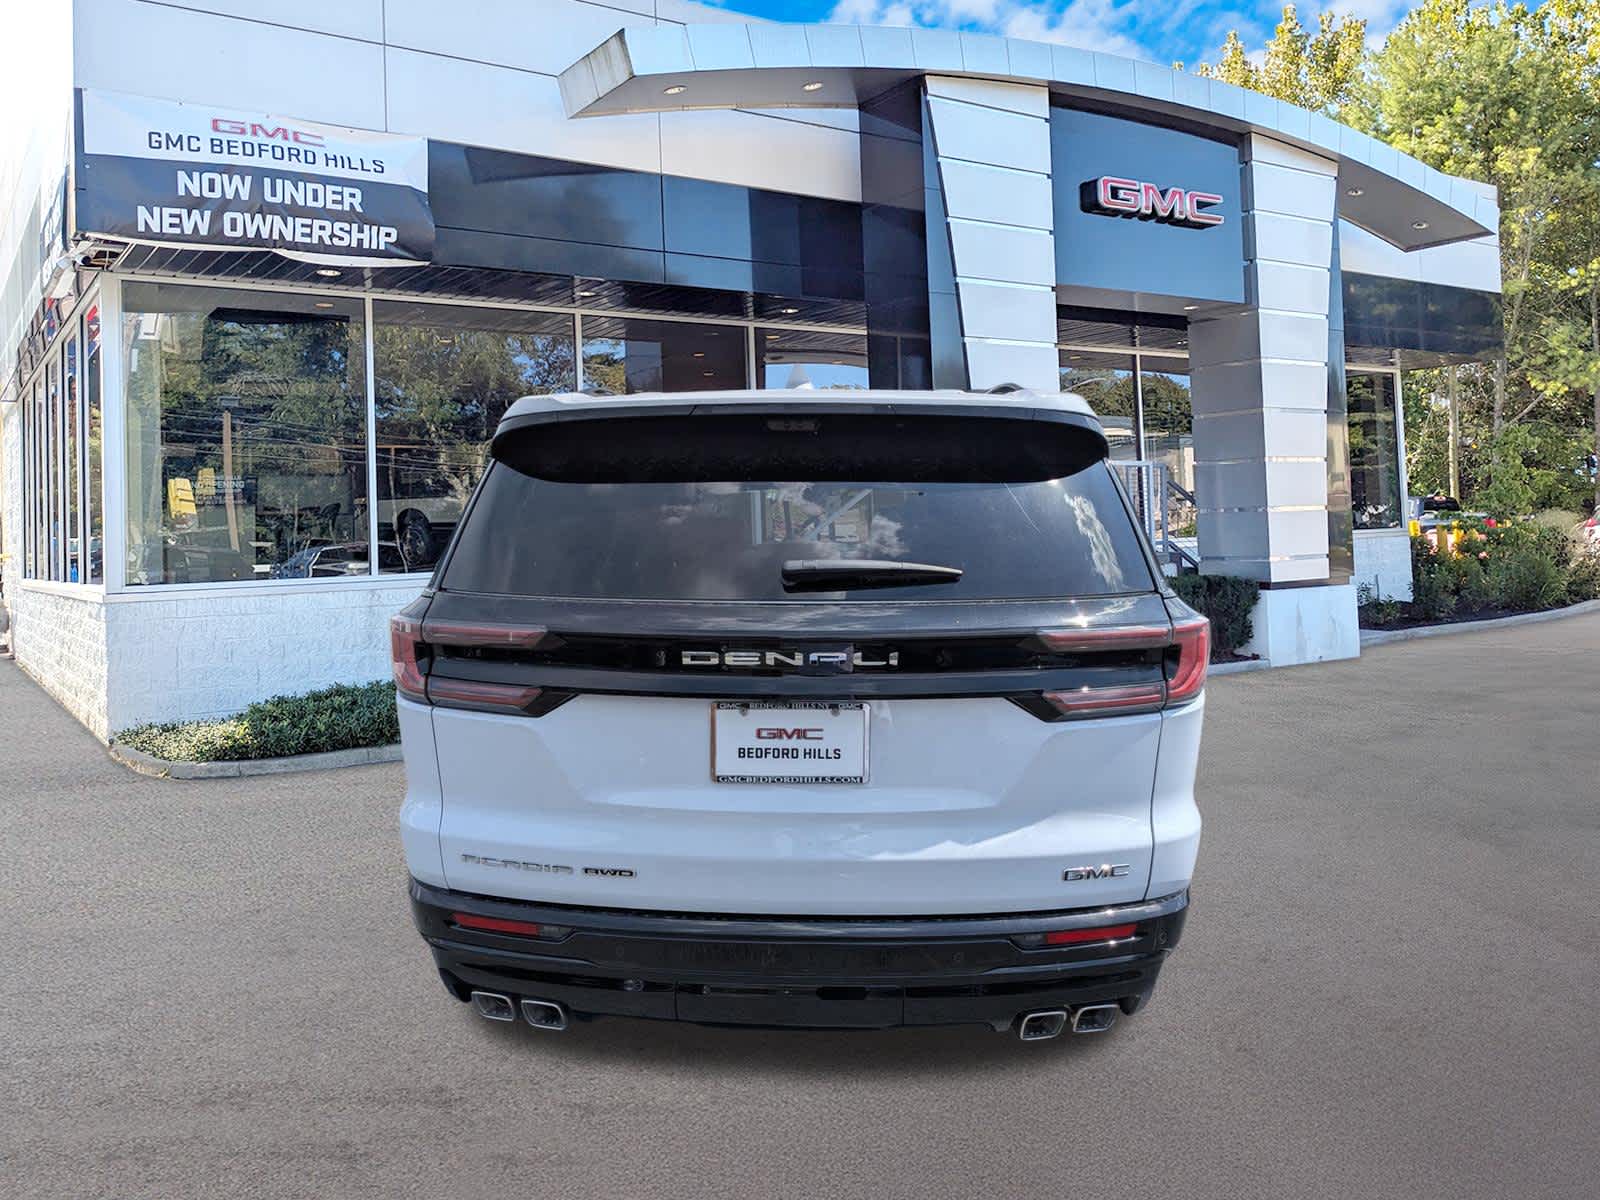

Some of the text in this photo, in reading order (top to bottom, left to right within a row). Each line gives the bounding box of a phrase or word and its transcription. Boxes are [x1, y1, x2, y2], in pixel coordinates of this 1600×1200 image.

[210, 118, 326, 147] GMC
[148, 131, 385, 174] GMC BEDFORD HILLS
[177, 170, 363, 213] NOW UNDER
[1098, 176, 1225, 224] GMC
[137, 205, 398, 251] NEW OWNERSHIP
[681, 650, 899, 666] DENALI
[755, 728, 824, 740] GMC
[737, 747, 841, 760] BEDFORD HILLS
[461, 854, 636, 878] ACADIA AWD
[1062, 864, 1130, 881] GMC
